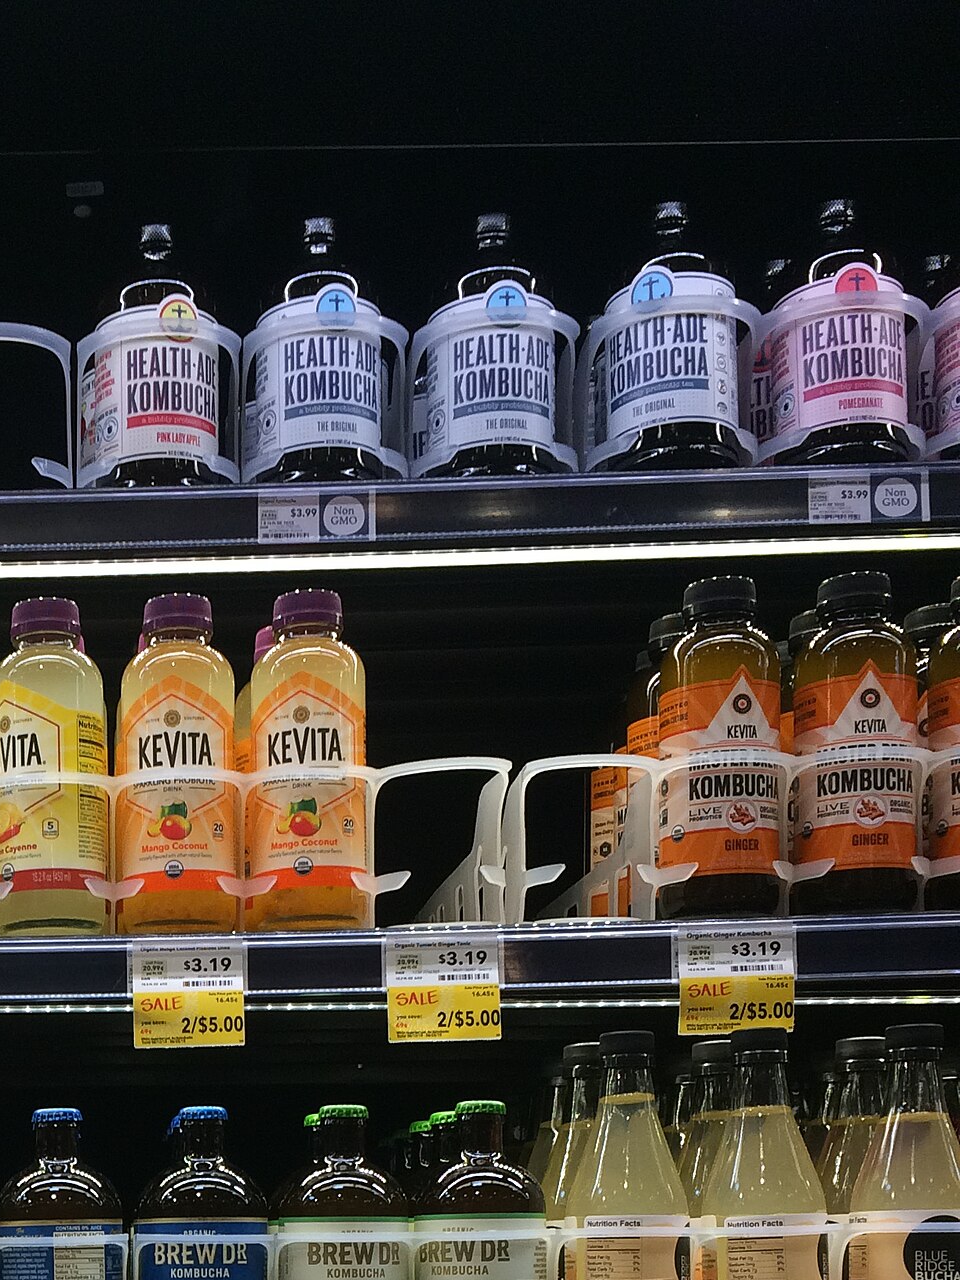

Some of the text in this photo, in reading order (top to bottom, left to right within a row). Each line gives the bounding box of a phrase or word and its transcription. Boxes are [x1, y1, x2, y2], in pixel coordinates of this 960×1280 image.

[803, 343, 904, 388] KOMBUCHA
[284, 371, 378, 410] KOMBUCHA
[126, 380, 217, 423] KOMBUCHA
[838, 397, 884, 410] POMEGRANATE
[317, 420, 358, 433] THE ORIGINAL
[156, 431, 201, 448] PINK LADY APPLE
[841, 490, 868, 499] $3.99
[885, 489, 906, 498] Non
[882, 498, 910, 506] GMO
[291, 508, 317, 517] $3.99
[334, 506, 354, 515] Non
[331, 516, 357, 525] GMO
[689, 772, 779, 800] KOMBUCHA
[817, 766, 913, 796] KOMBUCHA
[725, 838, 759, 852] GINGER
[852, 833, 888, 847] GINGER
[142, 842, 208, 853] Mango Coconut
[731, 941, 781, 956] $3.19
[439, 951, 487, 966] $3.19
[688, 981, 731, 998] SALE
[396, 990, 439, 1006] SALE
[730, 1001, 793, 1020] 2/$5.00
[437, 1010, 500, 1028] 2/$5.00
[154, 1242, 216, 1265] BREW
[914, 1250, 948, 1261] BLUE
[171, 1268, 230, 1278] KOMBUCHA
[327, 1268, 386, 1278] KOMBUCHA
[914, 1261, 955, 1271] RIDGE
